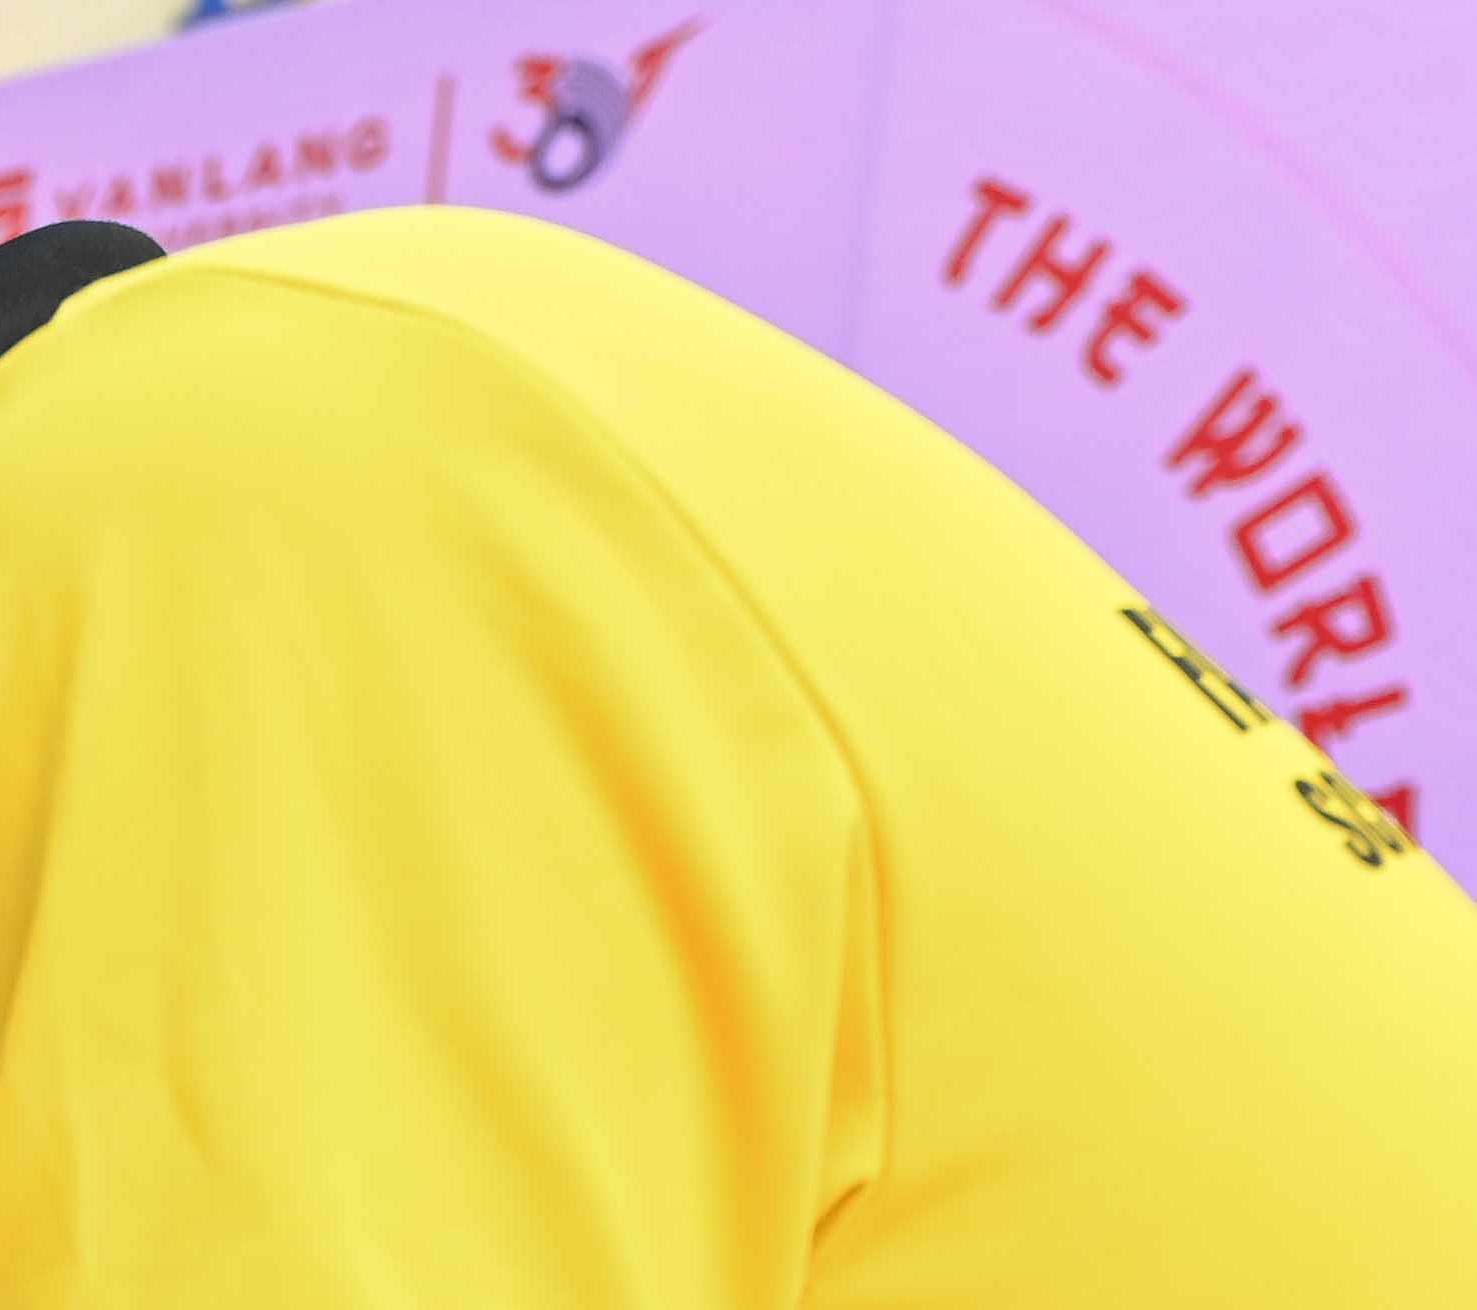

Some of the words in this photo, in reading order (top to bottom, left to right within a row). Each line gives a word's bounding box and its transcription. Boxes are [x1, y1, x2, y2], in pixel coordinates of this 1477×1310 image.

[52, 116, 393, 222] VANLANG
[926, 172, 1190, 390] THE
[1161, 364, 1423, 845] WORL
